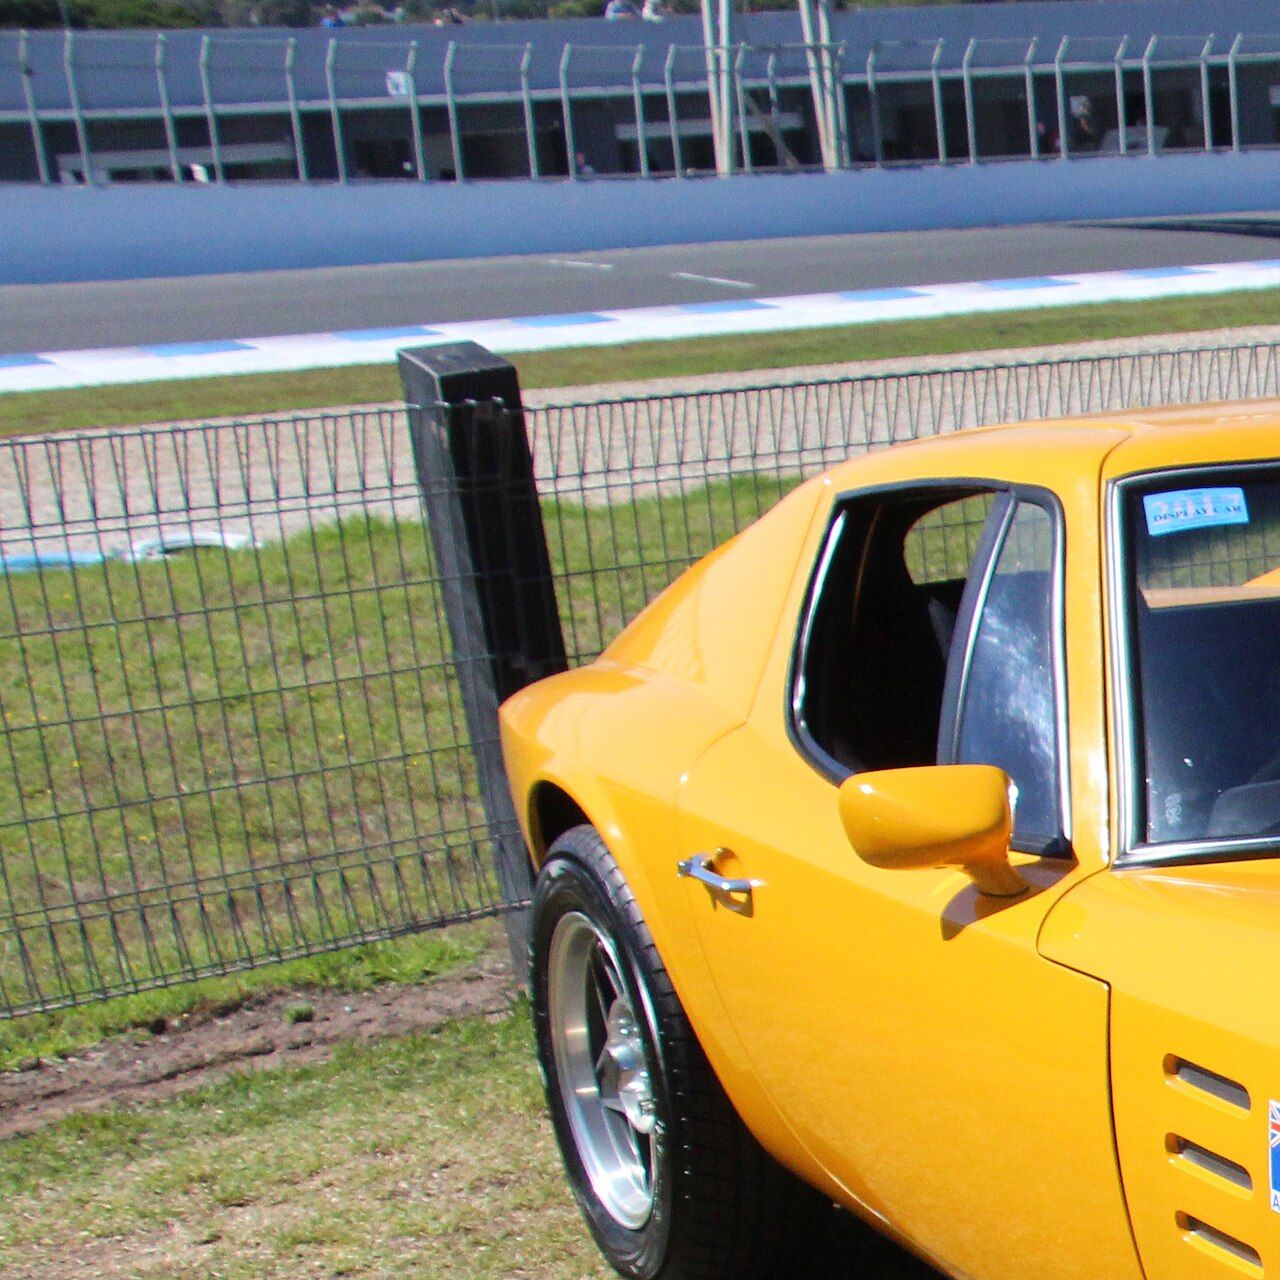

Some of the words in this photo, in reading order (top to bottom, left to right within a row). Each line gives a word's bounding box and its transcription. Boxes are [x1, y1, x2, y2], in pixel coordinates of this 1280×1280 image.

[1151, 495, 1240, 524] 2017
[1153, 506, 1209, 522] DISPLAY
[1211, 504, 1243, 515] CAR
